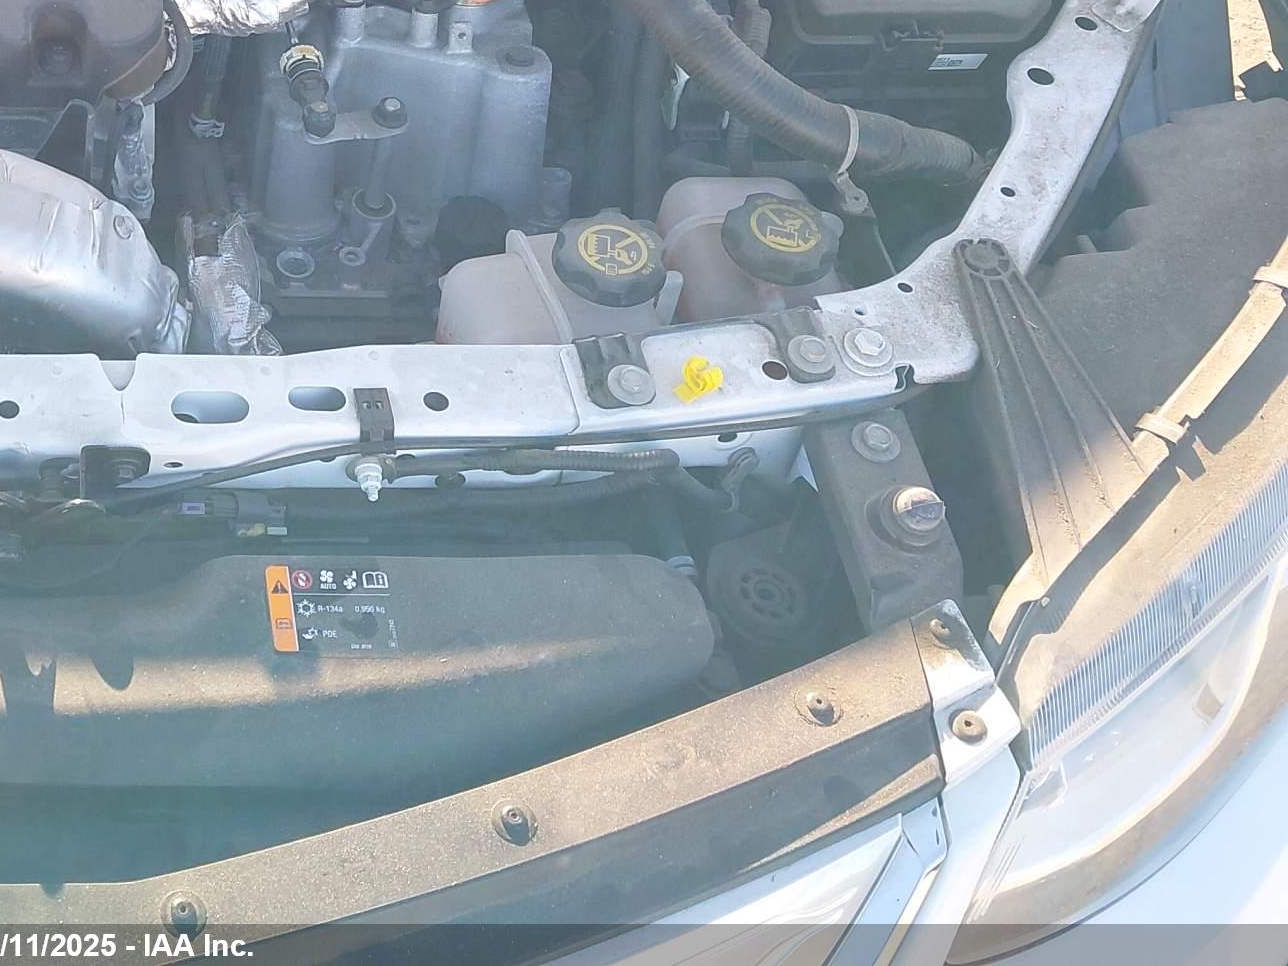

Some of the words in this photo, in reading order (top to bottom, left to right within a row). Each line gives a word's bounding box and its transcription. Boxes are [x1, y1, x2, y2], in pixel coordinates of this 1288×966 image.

[319, 582, 337, 590] AUTO
[317, 605, 343, 613] R-134a
[322, 630, 338, 638] POE
